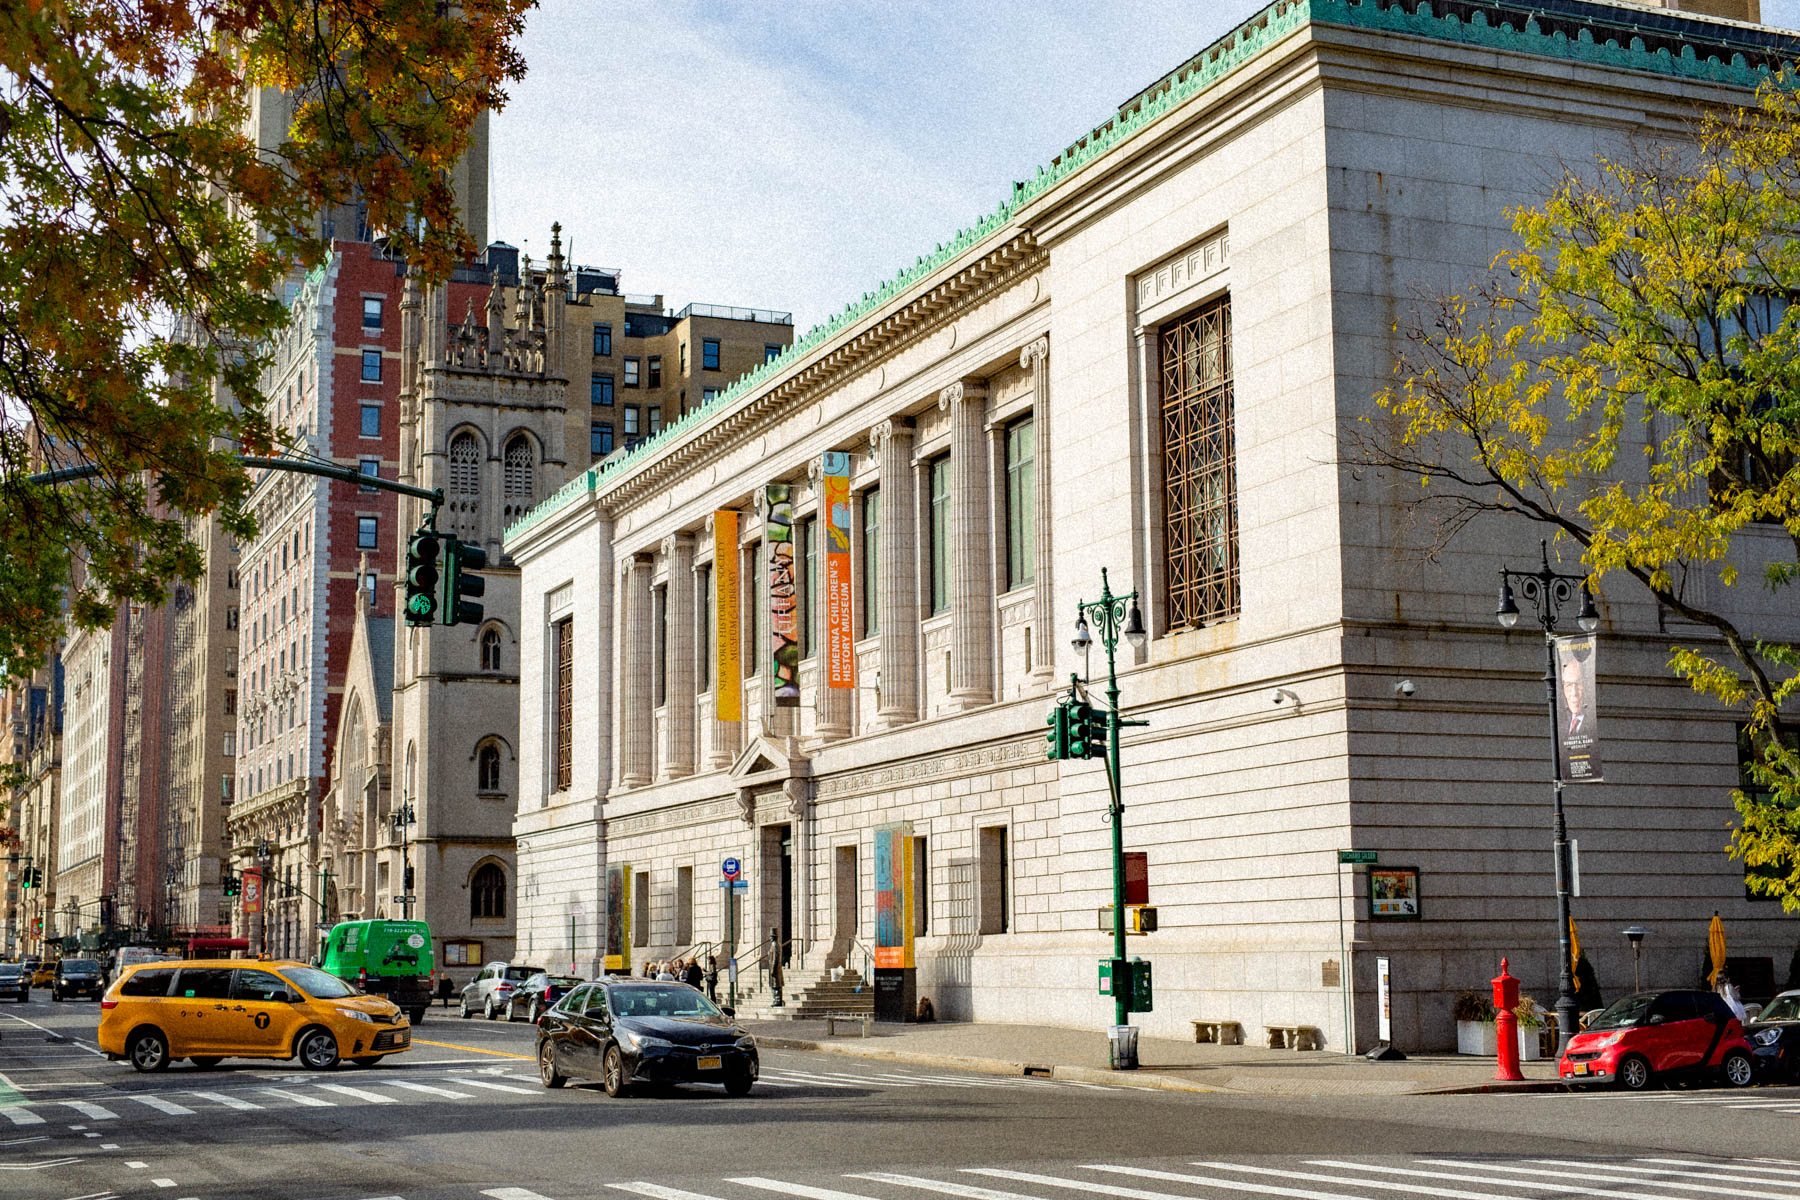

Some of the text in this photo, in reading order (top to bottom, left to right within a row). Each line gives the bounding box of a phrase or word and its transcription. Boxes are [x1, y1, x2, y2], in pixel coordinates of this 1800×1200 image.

[717, 541, 728, 691] NEW-YORK HISTORICAL SOCIETY
[728, 570, 737, 607] LIBRARY
[775, 554, 792, 639] TIFFANY
[829, 559, 841, 682] DIMENNA CHILDREN'S
[841, 582, 852, 682] HISTORY MUSEUM
[729, 619, 738, 662] MUSEUM
